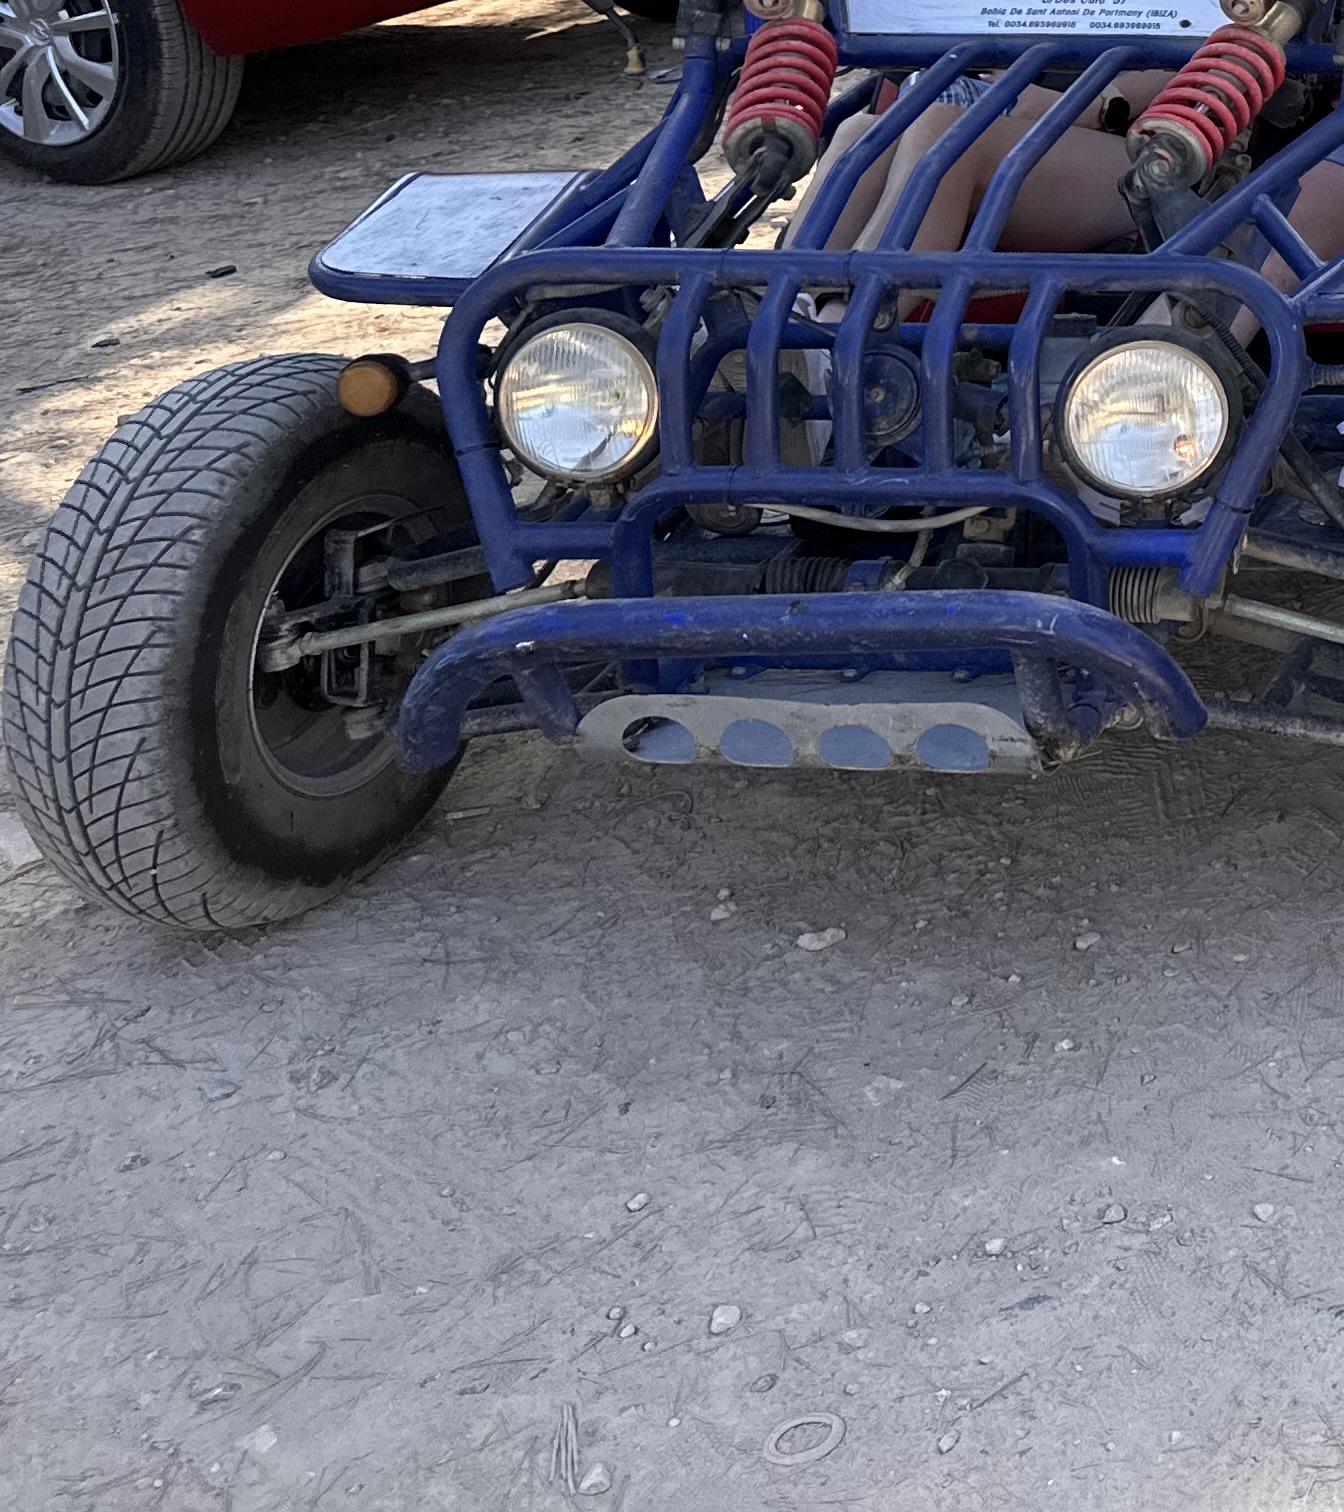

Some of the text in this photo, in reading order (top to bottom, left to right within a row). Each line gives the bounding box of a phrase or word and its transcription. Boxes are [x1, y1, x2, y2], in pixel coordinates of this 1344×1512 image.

[1009, 8, 1023, 16] De
[1025, 8, 1048, 16] Sant
[1082, 8, 1096, 17] De
[1146, 9, 1178, 19] (IBIZA)
